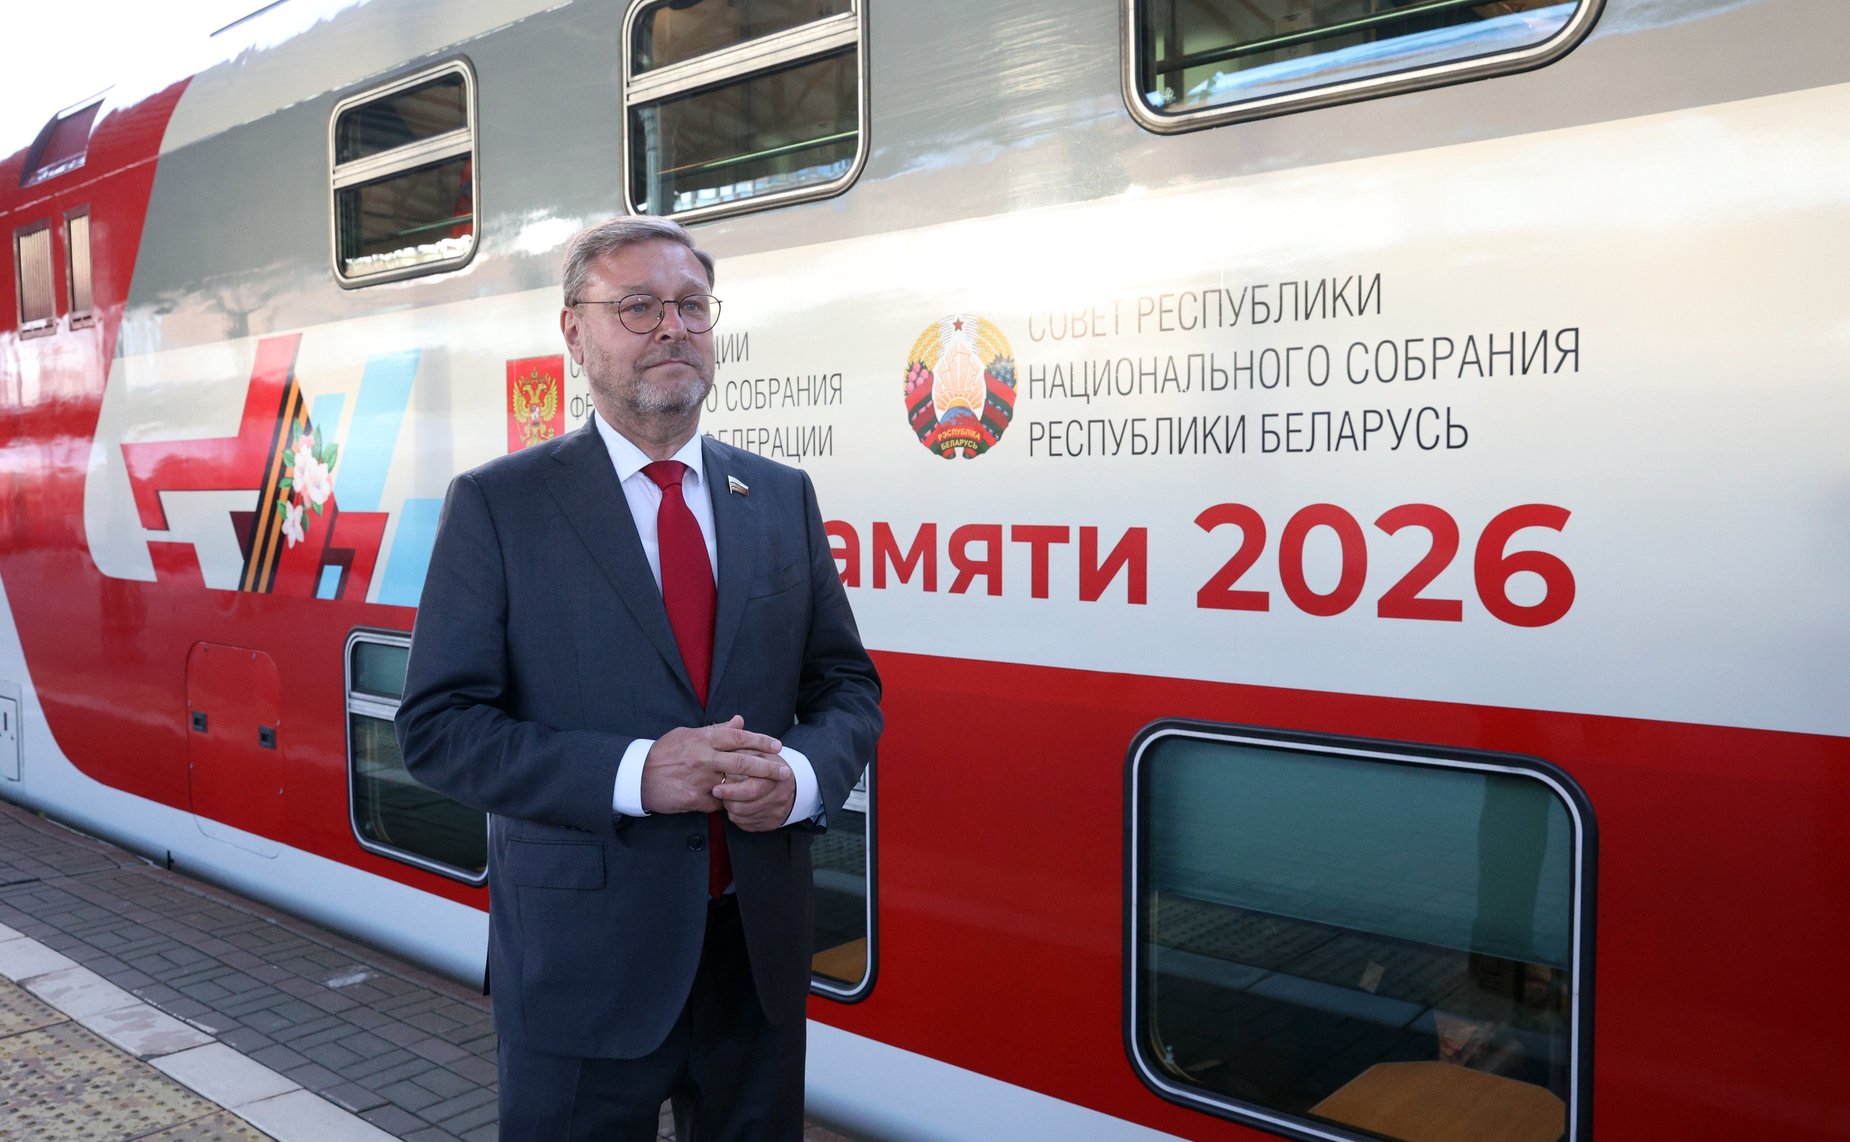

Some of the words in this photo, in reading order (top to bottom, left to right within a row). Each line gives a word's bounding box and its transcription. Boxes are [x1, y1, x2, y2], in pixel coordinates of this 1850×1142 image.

[1028, 299, 1121, 343] СОВЕТ
[1137, 273, 1382, 335] РЕСПУБЛИКИ
[1028, 344, 1330, 404] НАЦИОНАЛЬНОГО
[1346, 327, 1581, 385] СОБРАНИЯ
[725, 373, 842, 412] СОБРАНИЯ
[703, 424, 833, 463] ДЕРАЦИИ
[937, 428, 981, 441] РЭСПУБЛІКА
[940, 438, 978, 450] БЕЛАРУСЬ
[1029, 413, 1247, 458] РЕСПУБЛИКИ
[1261, 406, 1468, 455] БЕЛАРУСЬ
[823, 520, 1147, 605] амяти
[1193, 502, 1576, 628] 2026
